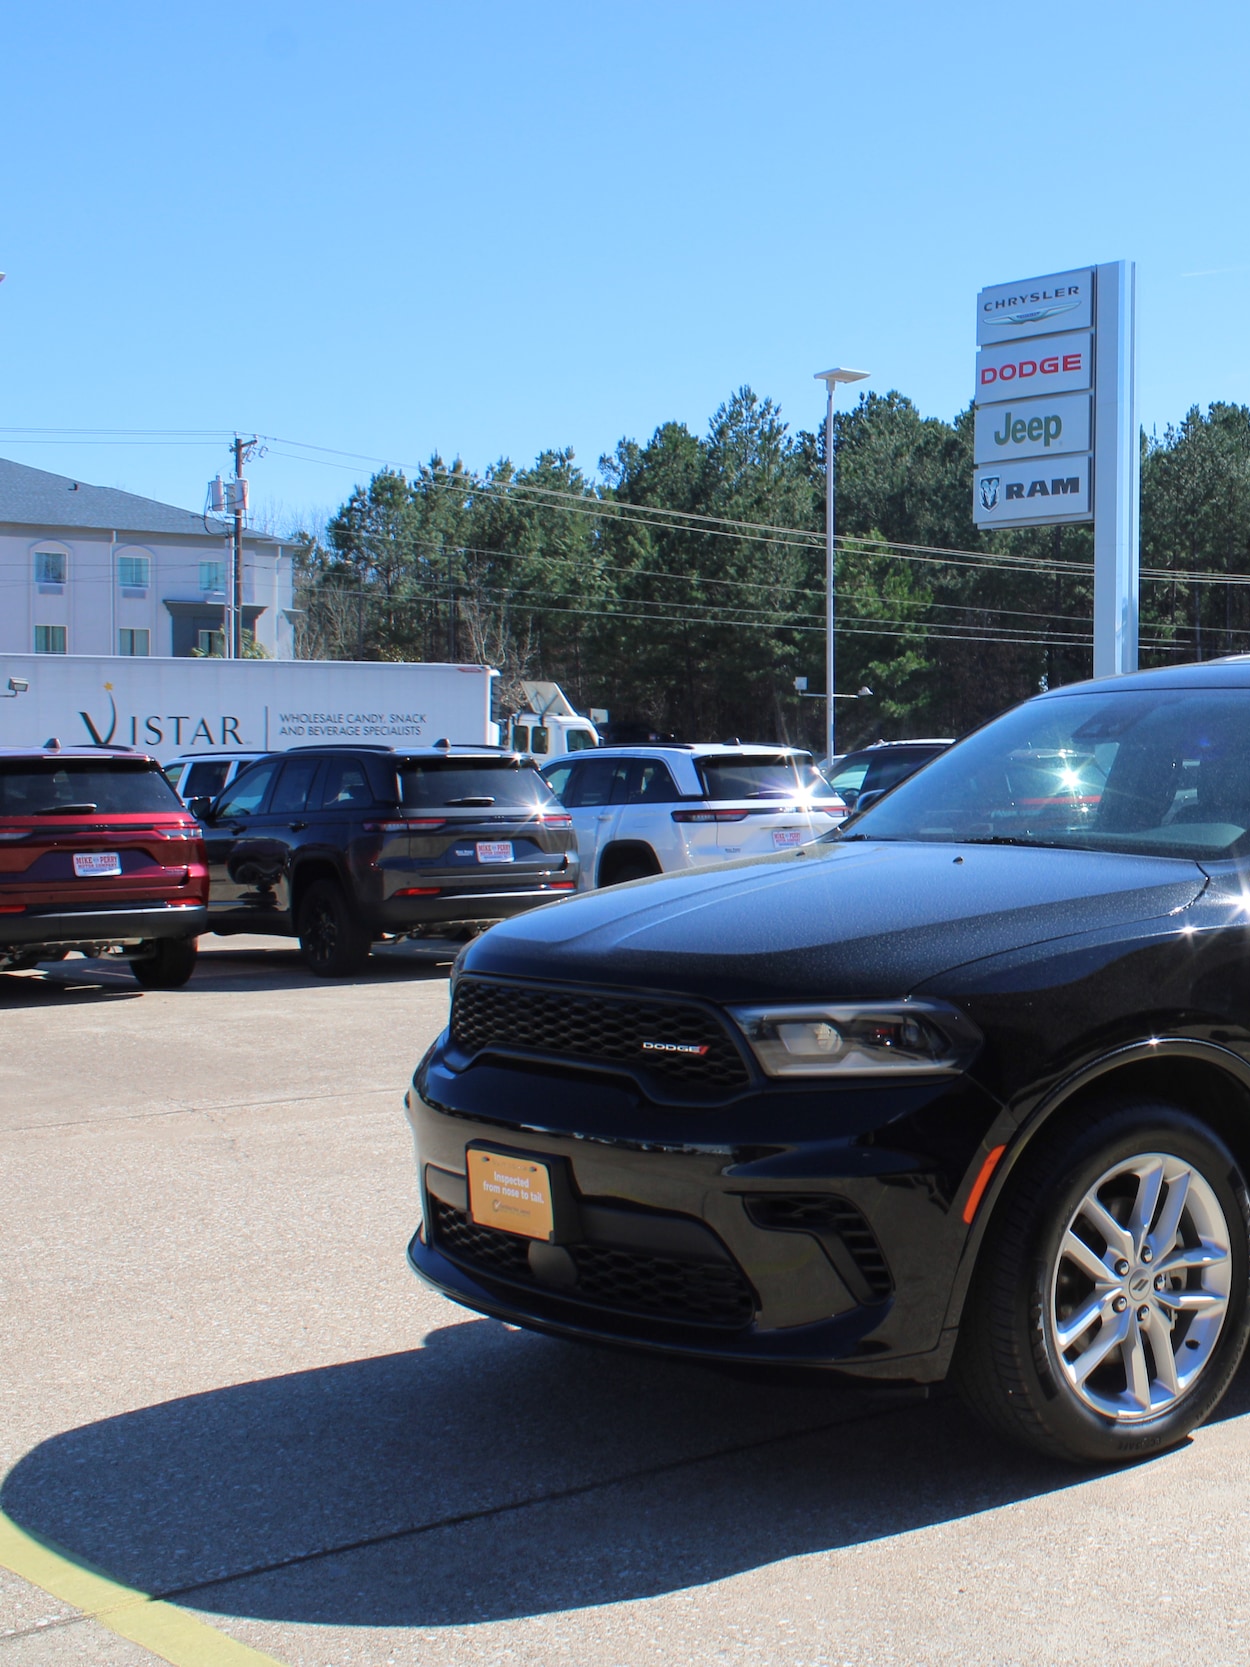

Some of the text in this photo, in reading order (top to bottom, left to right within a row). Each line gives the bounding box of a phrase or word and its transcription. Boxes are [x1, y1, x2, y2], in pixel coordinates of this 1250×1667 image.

[983, 285, 1080, 312] CHRYSLER
[980, 353, 1082, 385] DODGE
[993, 412, 1062, 447] Jeep
[1005, 476, 1080, 500] RAM
[78, 692, 244, 746] VISTAR
[279, 713, 344, 724] WHOLESALE
[390, 713, 427, 723] SNACK
[279, 725, 422, 736] AND BEVERAGE SPECIALISTS
[76, 855, 117, 865] MIKE PERRY
[643, 1041, 700, 1053] DODGE
[494, 1171, 530, 1188] Inspected
[483, 1180, 545, 1204] from nose to tail.
